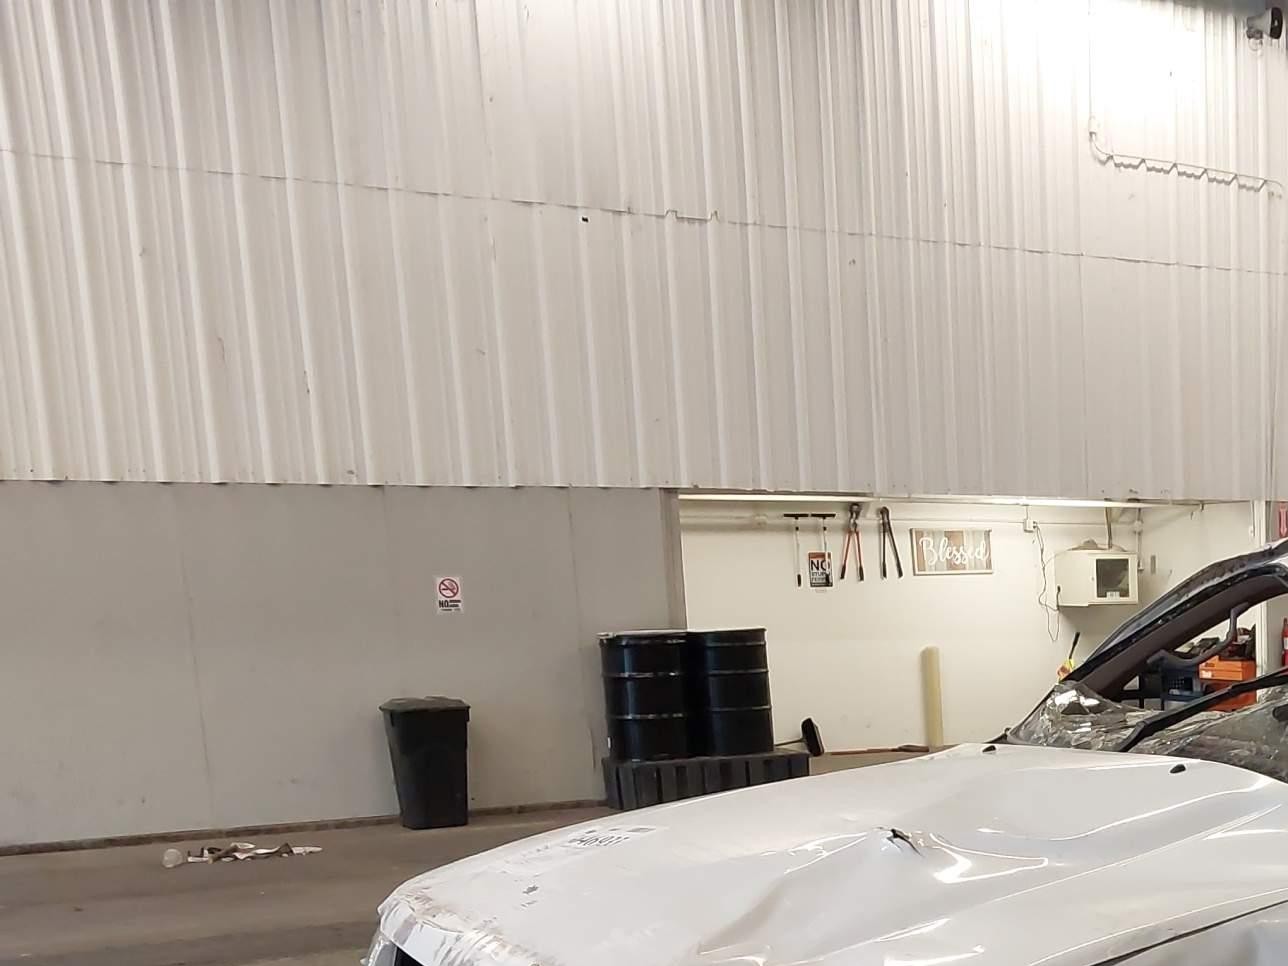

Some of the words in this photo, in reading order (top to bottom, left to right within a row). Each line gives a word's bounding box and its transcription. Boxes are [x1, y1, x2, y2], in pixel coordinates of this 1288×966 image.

[919, 537, 989, 565] Blessed
[811, 559, 830, 571] NO
[439, 600, 449, 608] NO
